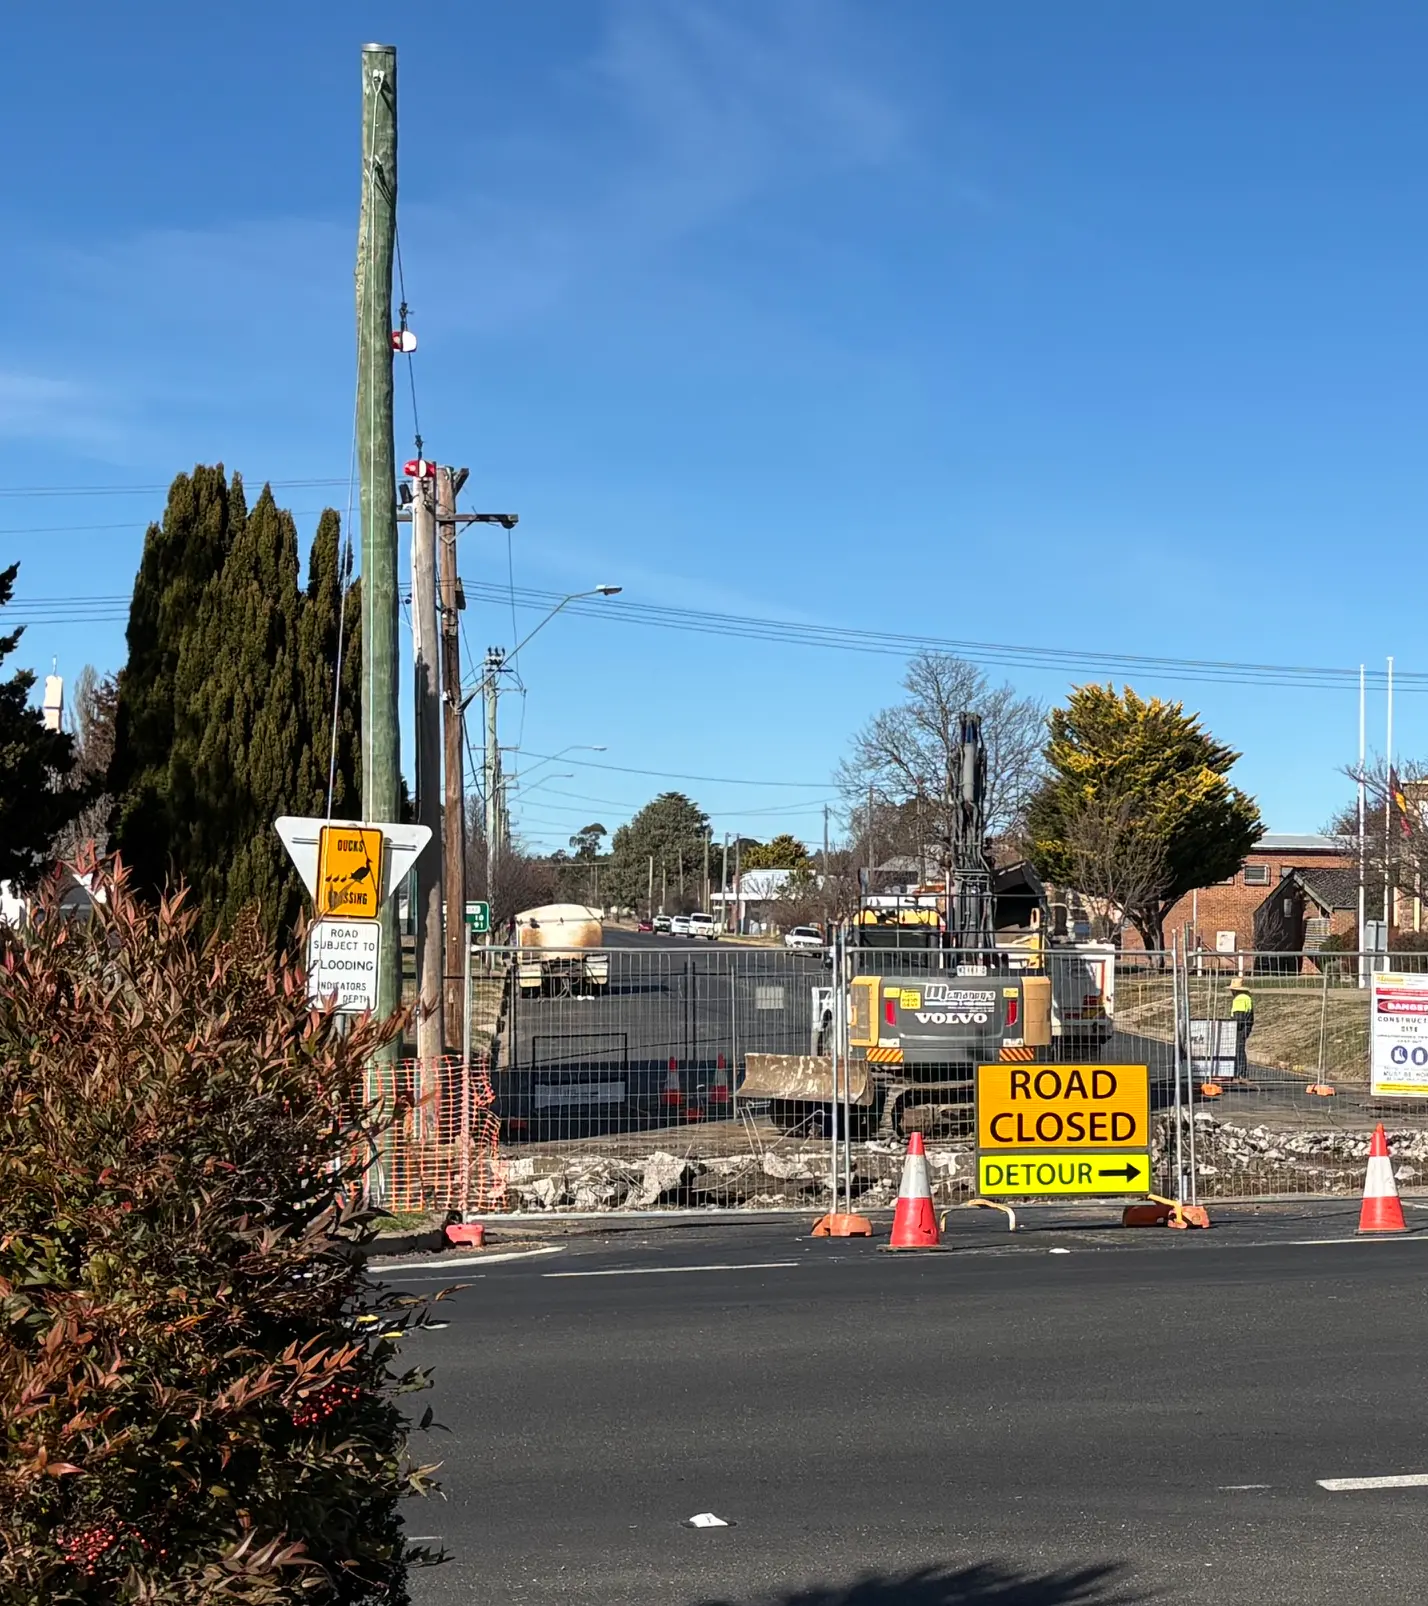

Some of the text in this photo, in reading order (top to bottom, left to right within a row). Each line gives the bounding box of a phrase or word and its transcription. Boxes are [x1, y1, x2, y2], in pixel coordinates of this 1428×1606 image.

[337, 839, 364, 853] DUCKS
[328, 891, 368, 905] SSING
[330, 928, 359, 938] ROAD
[313, 940, 375, 951] SUBJECT TO
[914, 1012, 988, 1024] VOLVO
[1009, 1069, 1118, 1101] ROAD
[989, 1111, 1137, 1143] CLOSED
[985, 1162, 1093, 1187] DETOUR
